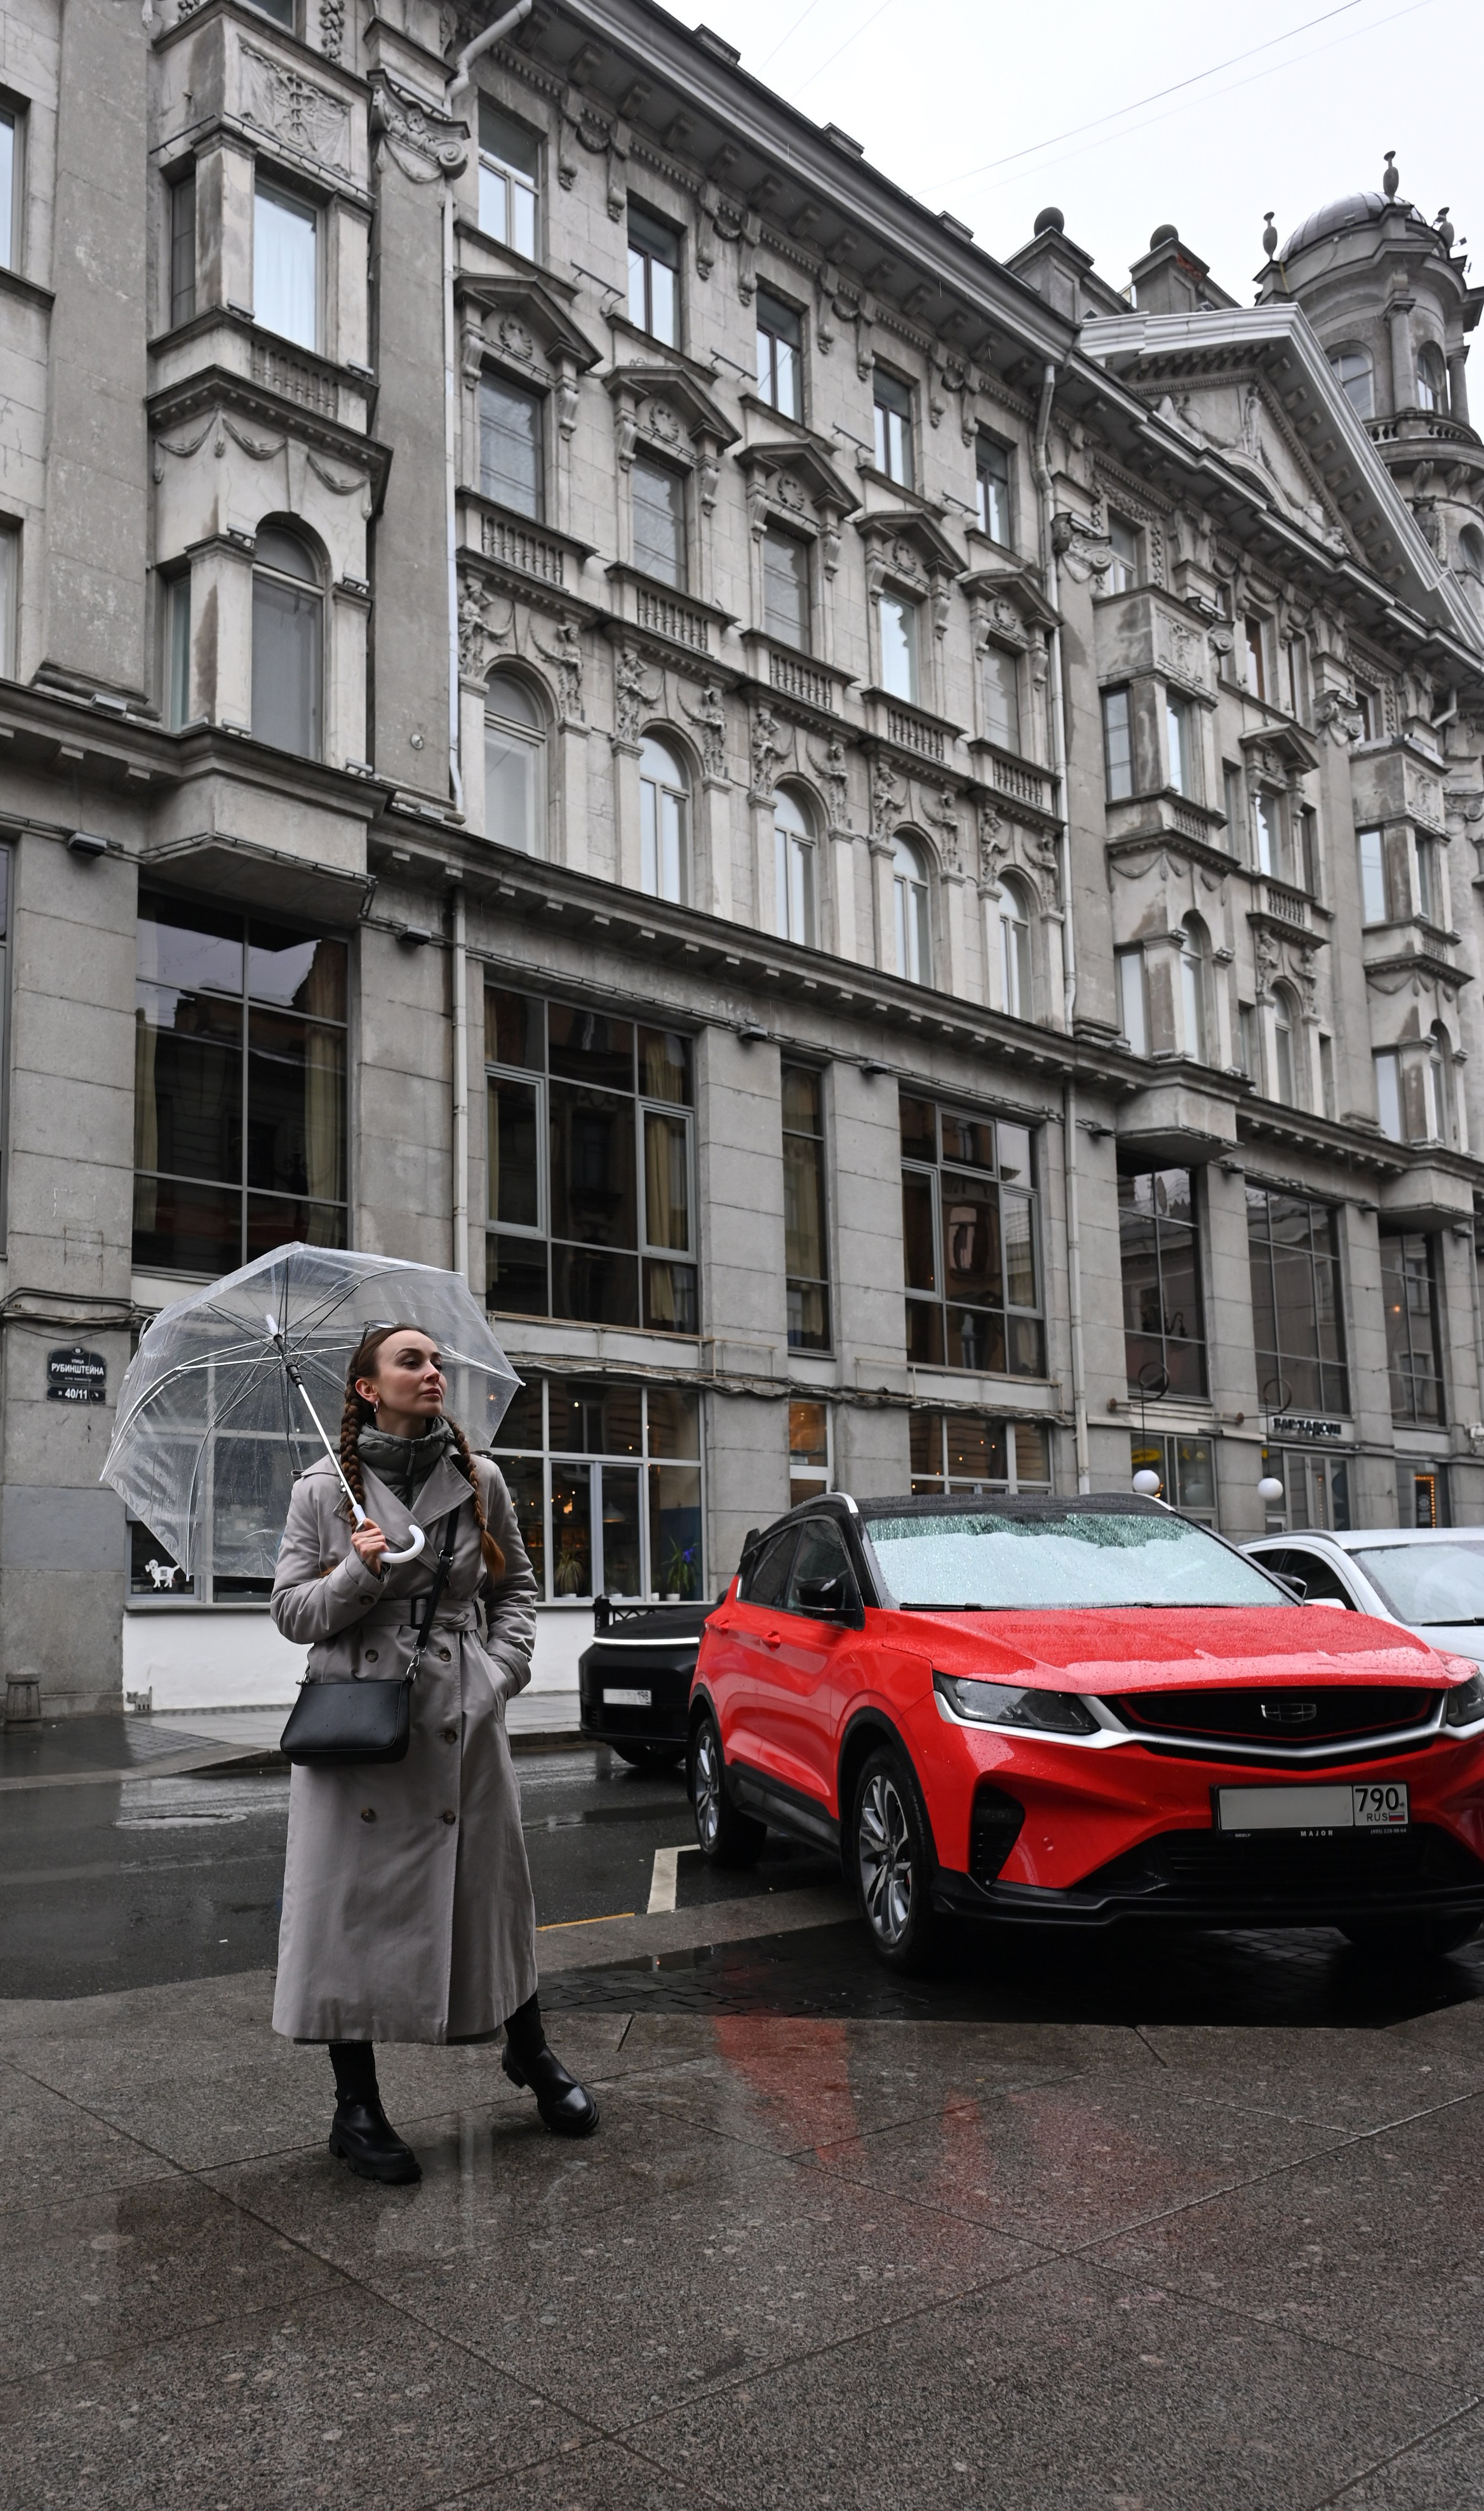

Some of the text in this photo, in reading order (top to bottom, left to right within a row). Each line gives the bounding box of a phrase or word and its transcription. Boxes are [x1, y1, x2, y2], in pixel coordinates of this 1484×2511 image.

[51, 1363, 104, 1376] РУБИНШТЕЙНА
[65, 1388, 88, 1399] 40/11
[1355, 1787, 1399, 1811] 790
[1367, 1813, 1388, 1822] RUS
